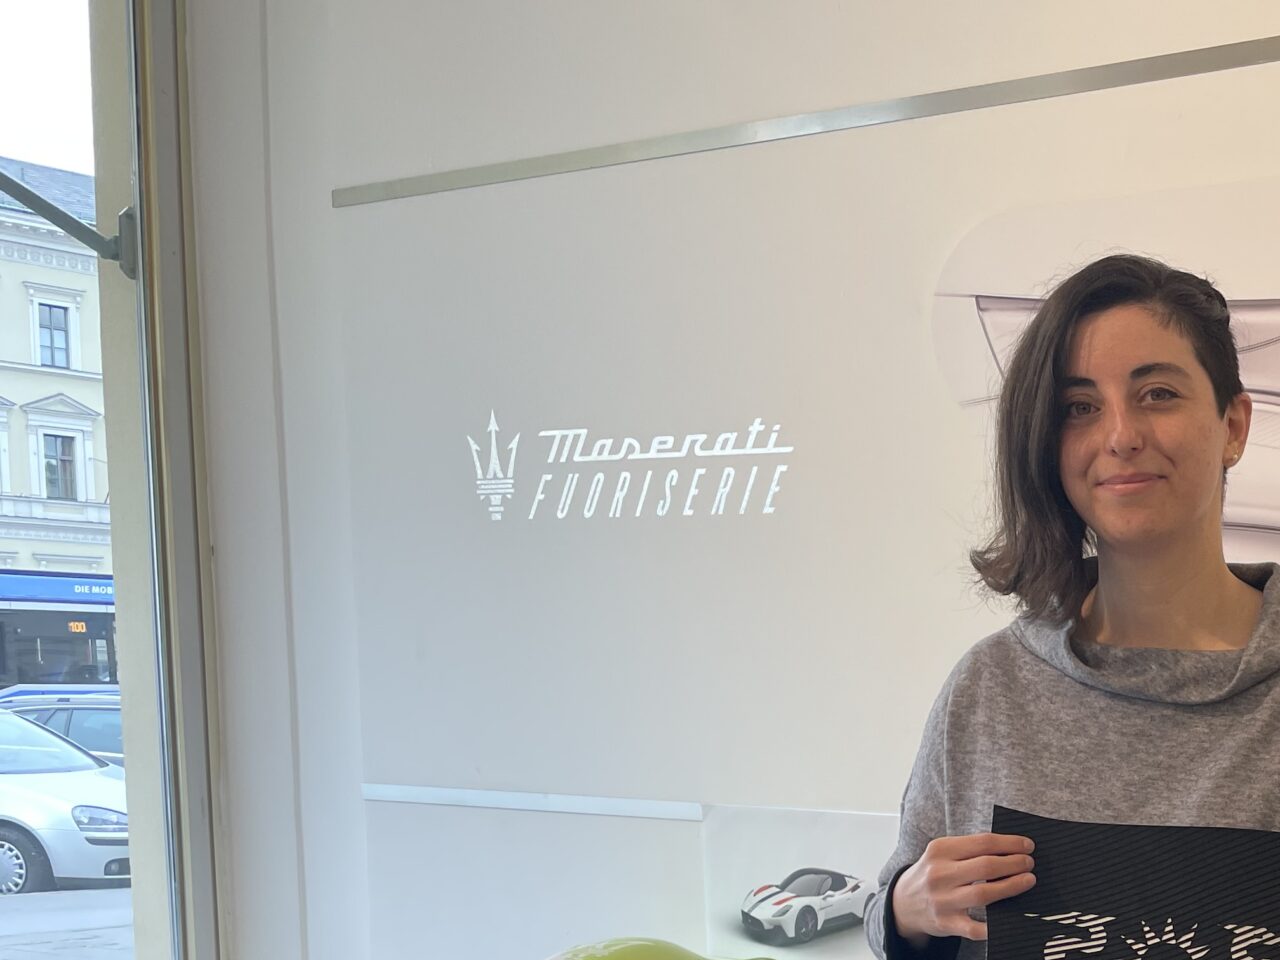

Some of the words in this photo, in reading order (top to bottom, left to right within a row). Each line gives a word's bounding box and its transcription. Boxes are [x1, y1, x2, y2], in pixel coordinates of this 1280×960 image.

[538, 417, 794, 464] Maserati
[528, 464, 788, 520] FUORISERIE
[74, 585, 90, 593] DIE
[68, 621, 87, 633] 100
